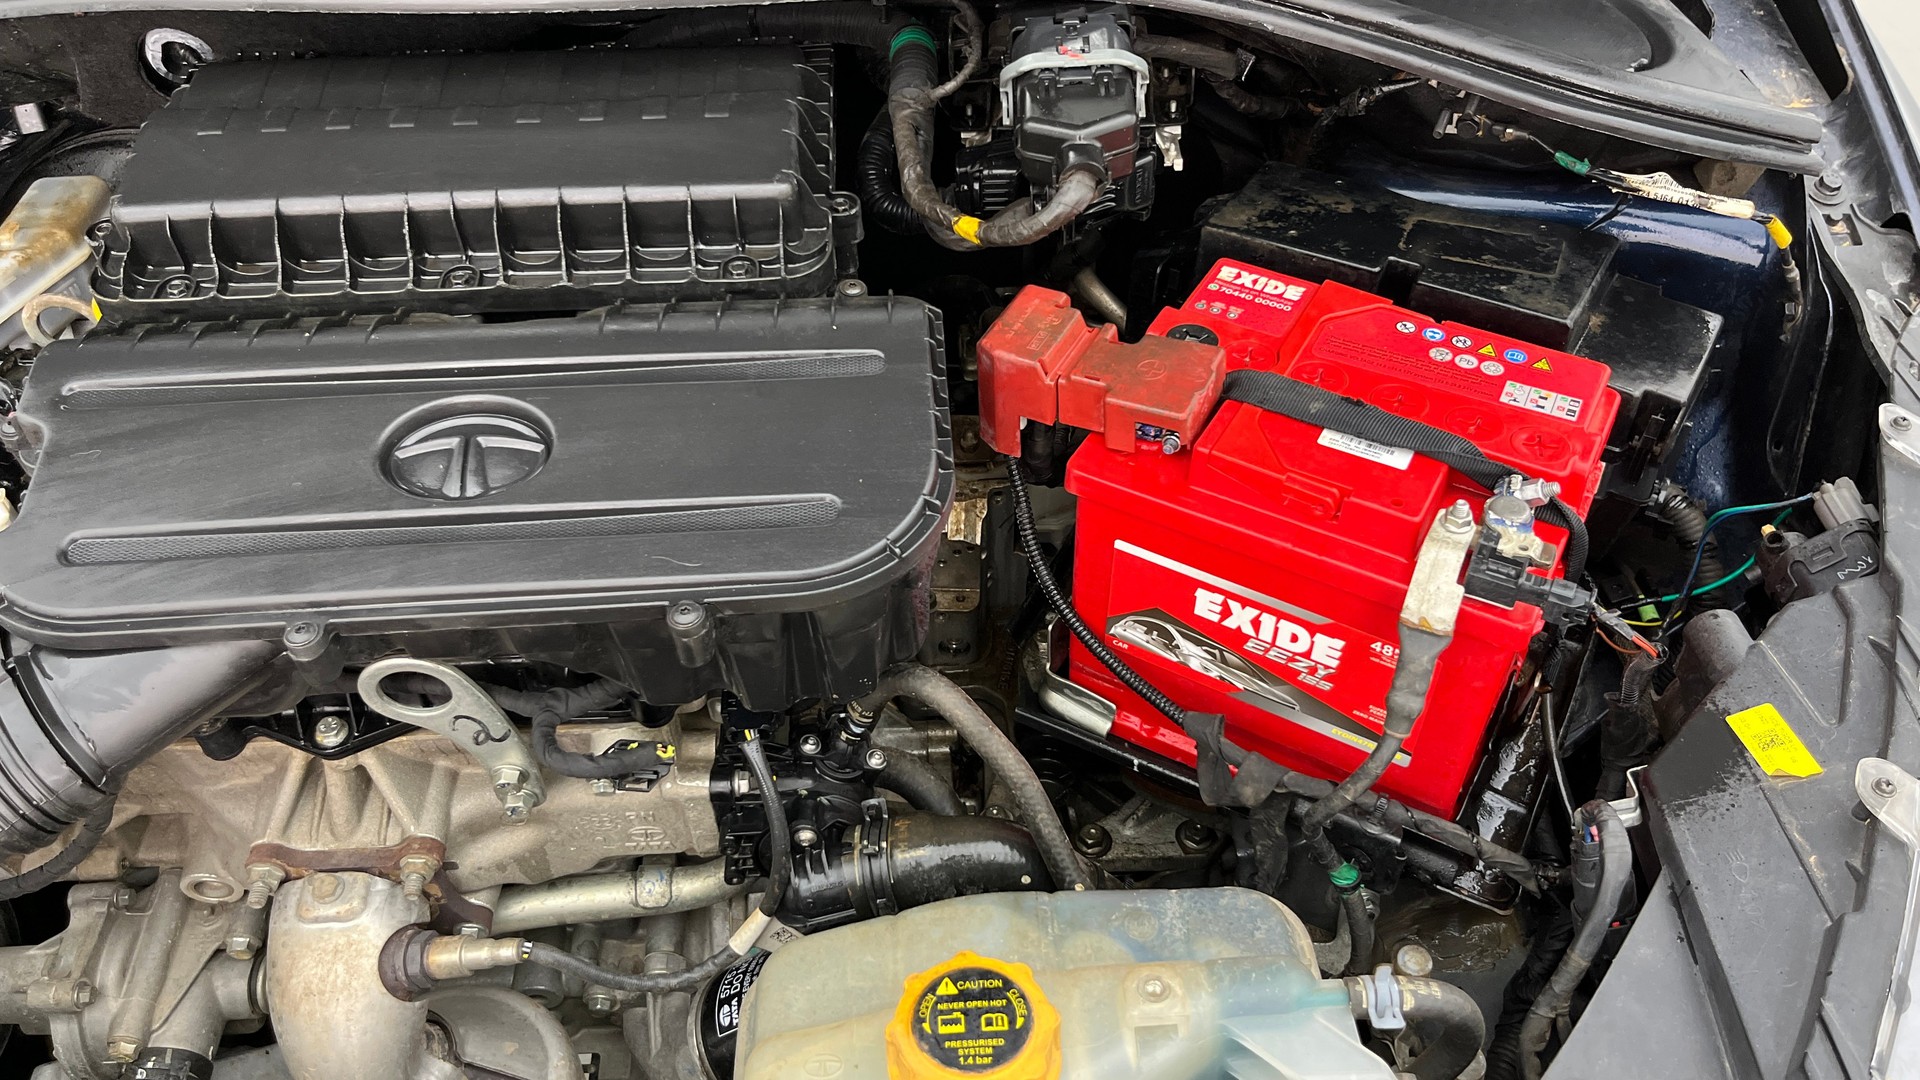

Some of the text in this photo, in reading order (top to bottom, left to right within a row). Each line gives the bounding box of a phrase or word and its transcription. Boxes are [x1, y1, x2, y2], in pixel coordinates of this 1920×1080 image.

[1216, 265, 1307, 301] EXIDE
[1219, 286, 1253, 300] 70440
[1254, 297, 1292, 312] 00000
[1458, 357, 1474, 366] Pb
[1193, 587, 1347, 668] EXIDE
[1112, 640, 1129, 650] CAR
[1243, 638, 1337, 679] EEZY
[1297, 672, 1334, 691] ISS
[731, 974, 743, 994] DO
[957, 979, 1003, 989] CAUTION
[731, 997, 739, 1026] TATA
[919, 992, 935, 1018] OPEN
[937, 999, 1007, 1010] NEVER OPEN HOT
[1009, 988, 1027, 1016] CLOSE
[945, 1038, 1005, 1048] PRESSURISED
[958, 1047, 993, 1055] SYSTEM
[959, 1056, 993, 1065] 1.4 bar
